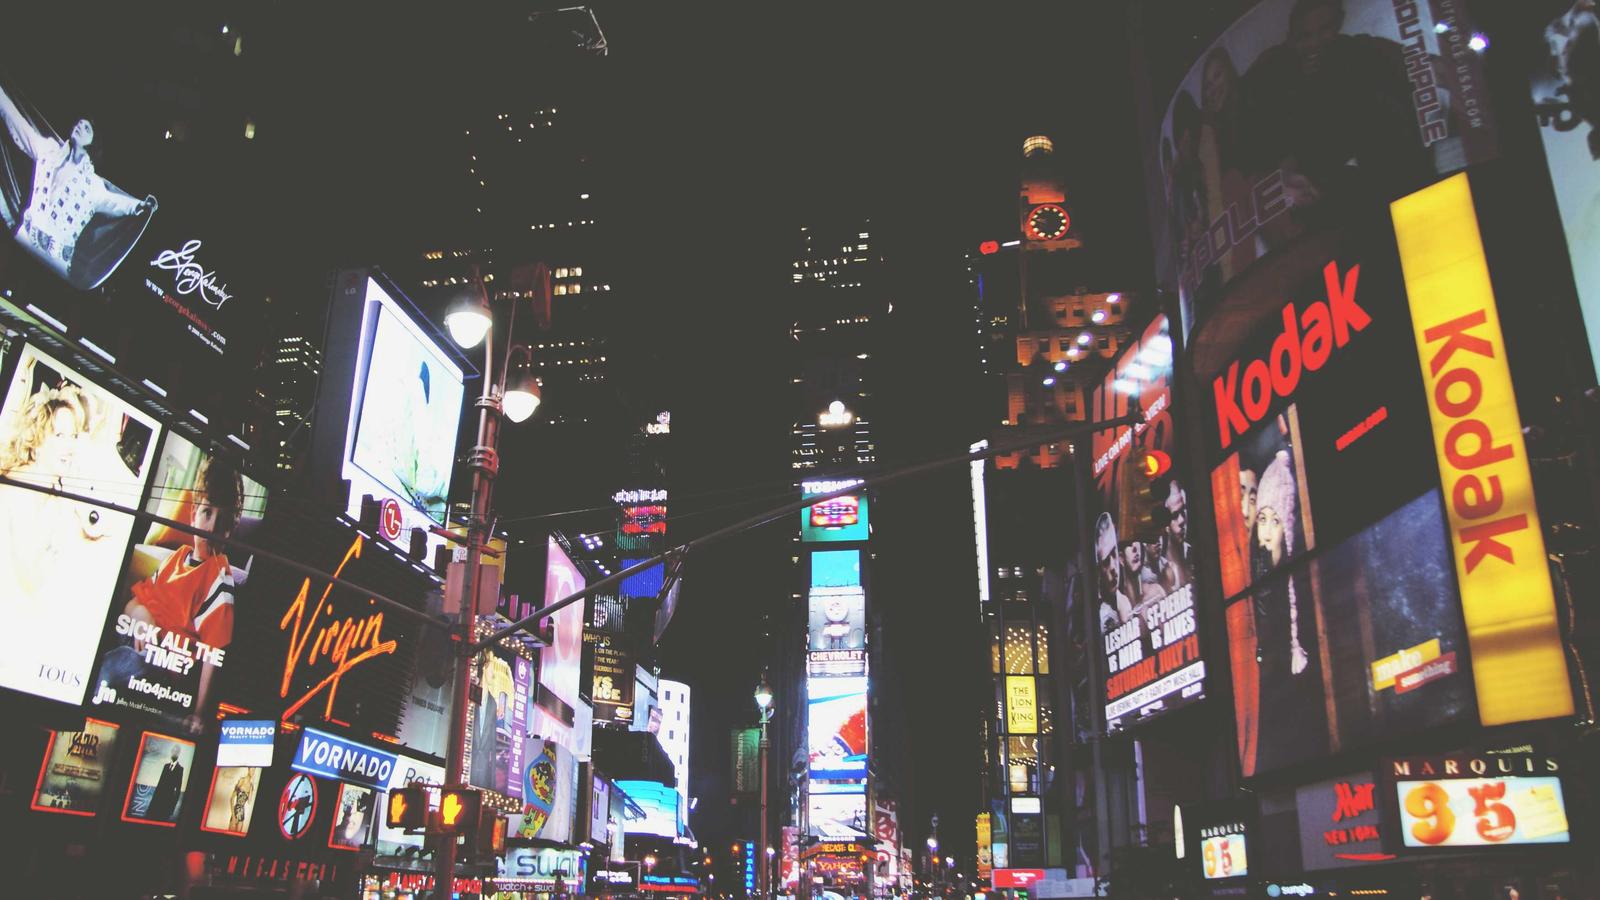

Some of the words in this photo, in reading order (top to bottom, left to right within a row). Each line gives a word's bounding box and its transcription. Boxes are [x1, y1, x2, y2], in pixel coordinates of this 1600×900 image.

[1213, 260, 1373, 449] Kodak
[1108, 441, 1120, 460] ON
[1423, 308, 1529, 576] Kodak
[279, 534, 397, 720] Virgin
[115, 613, 159, 645] SICK
[160, 631, 193, 657] ALL
[194, 640, 226, 668] THE
[144, 643, 195, 676] TIME?
[810, 650, 863, 662] CHEVROLET
[1157, 640, 1184, 675] JULY
[1184, 633, 1200, 661] 11
[37, 663, 82, 687] TOUS
[92, 680, 116, 705] jm
[128, 675, 193, 708] info4pi.org
[1013, 687, 1030, 695] THE
[1010, 697, 1033, 711] LION
[1010, 711, 1034, 726] KING
[221, 727, 275, 736] VORNADO
[302, 736, 392, 786] VORNADO
[1393, 758, 1559, 776] MARQUIS
[1200, 823, 1246, 838] MARQUIS
[1324, 828, 1349, 846] NEW
[1350, 825, 1380, 843] YORK
